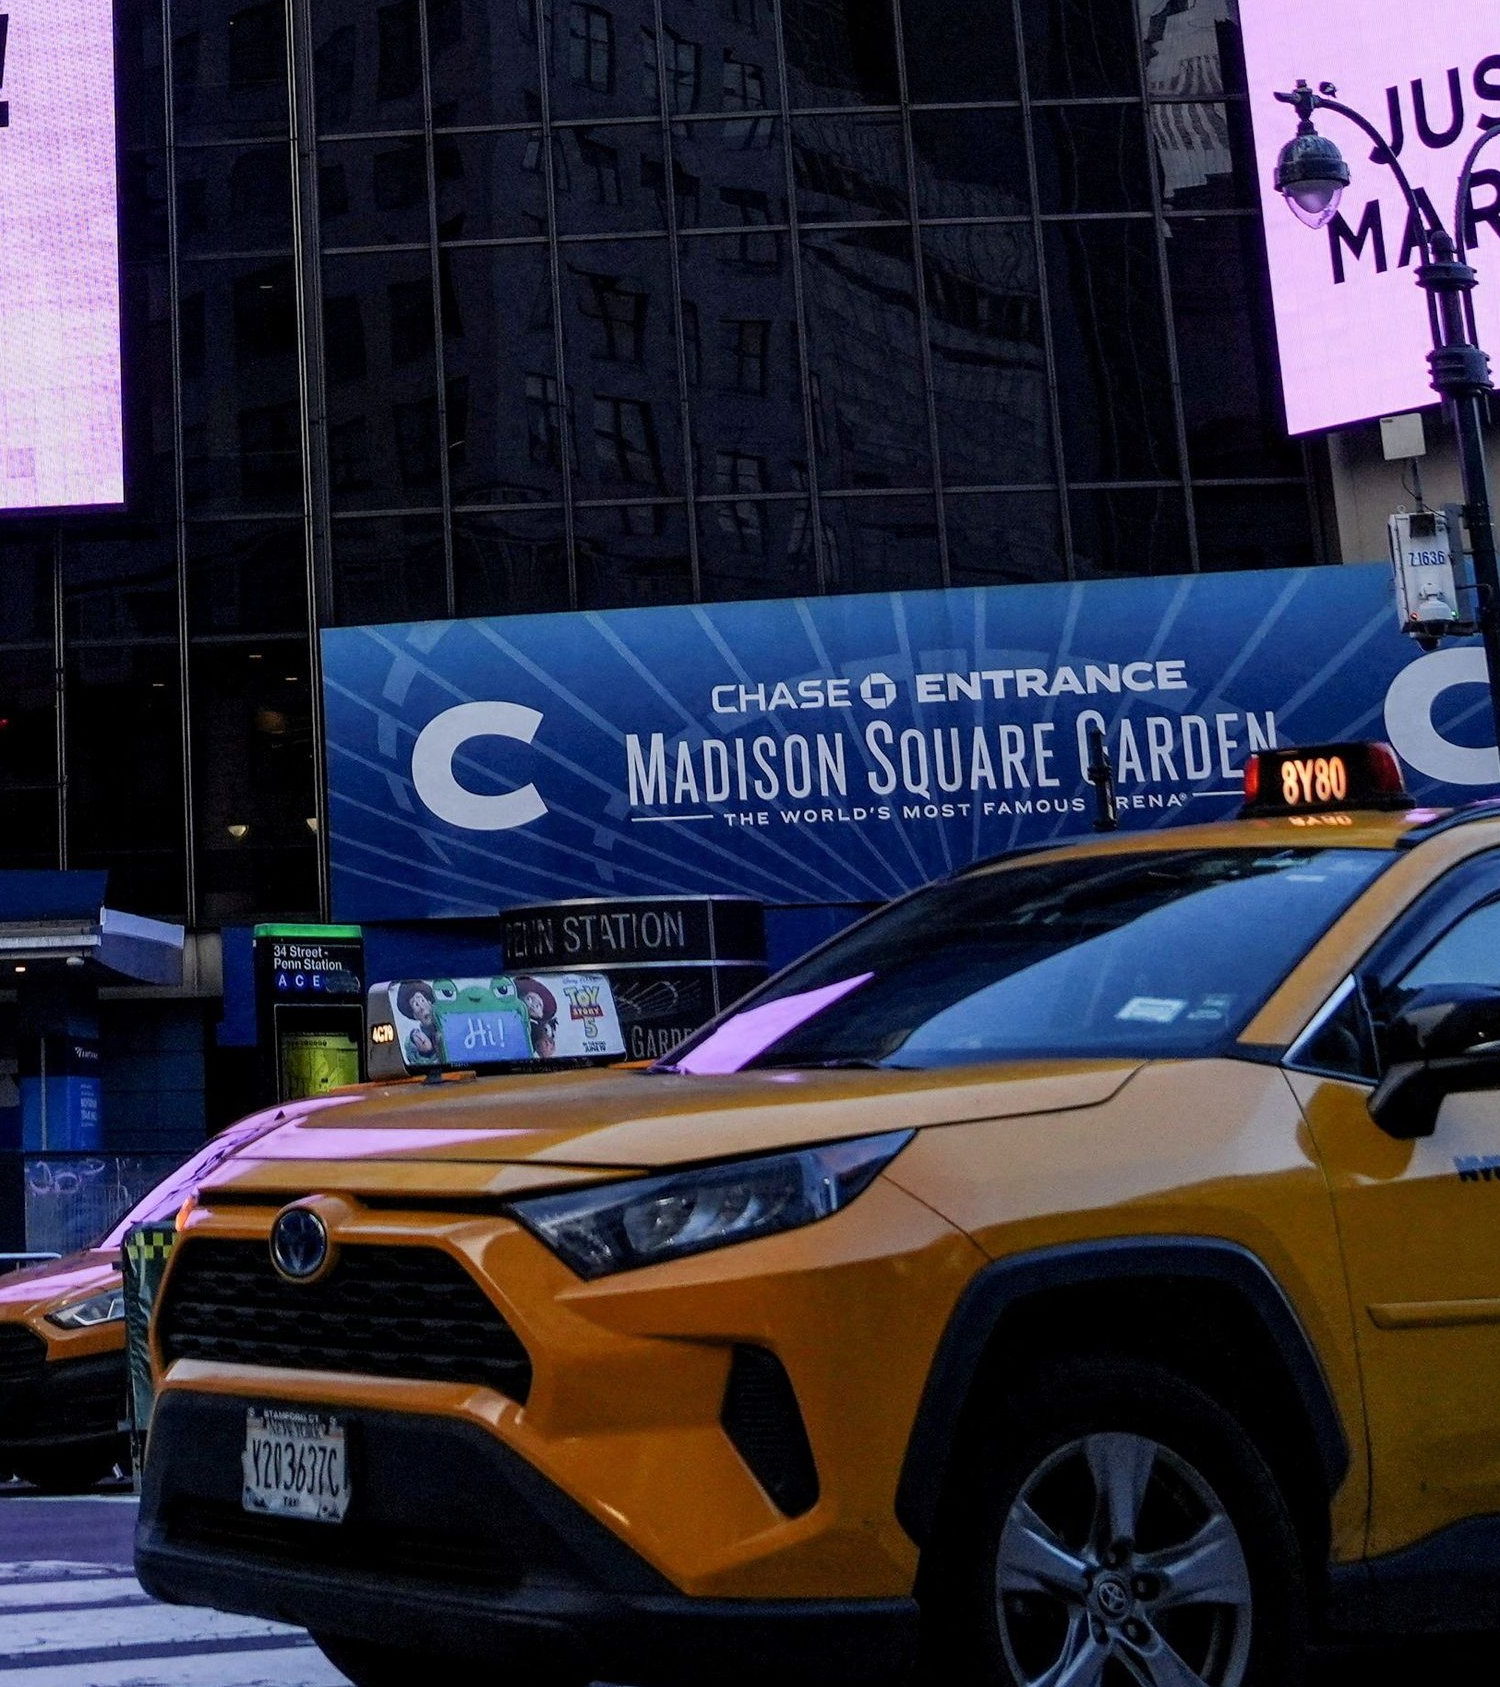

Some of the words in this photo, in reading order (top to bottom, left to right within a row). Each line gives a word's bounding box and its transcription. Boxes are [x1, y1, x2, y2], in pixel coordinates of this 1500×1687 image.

[711, 676, 852, 714] CHASE
[915, 659, 1188, 704] ENTRANCE
[410, 701, 549, 832] C
[627, 731, 847, 808] MADISON
[865, 718, 1060, 800] SQUARE
[1077, 708, 1279, 786] GARDEN
[1281, 756, 1347, 806] 8Y80
[724, 811, 770, 826] THE
[774, 805, 892, 825] WORLD'S
[902, 802, 973, 820] MOST
[983, 797, 1086, 817] FAMOUS
[563, 911, 685, 953] STATION
[273, 945, 287, 957] 34
[273, 957, 301, 970] Penn
[304, 958, 342, 971] Station
[278, 974, 288, 987] A
[295, 975, 304, 987] C
[312, 975, 321, 987] E
[564, 985, 600, 1006] TOY
[572, 1006, 601, 1016] STORY
[464, 1018, 505, 1049] Hi!
[583, 1019, 598, 1039] 5
